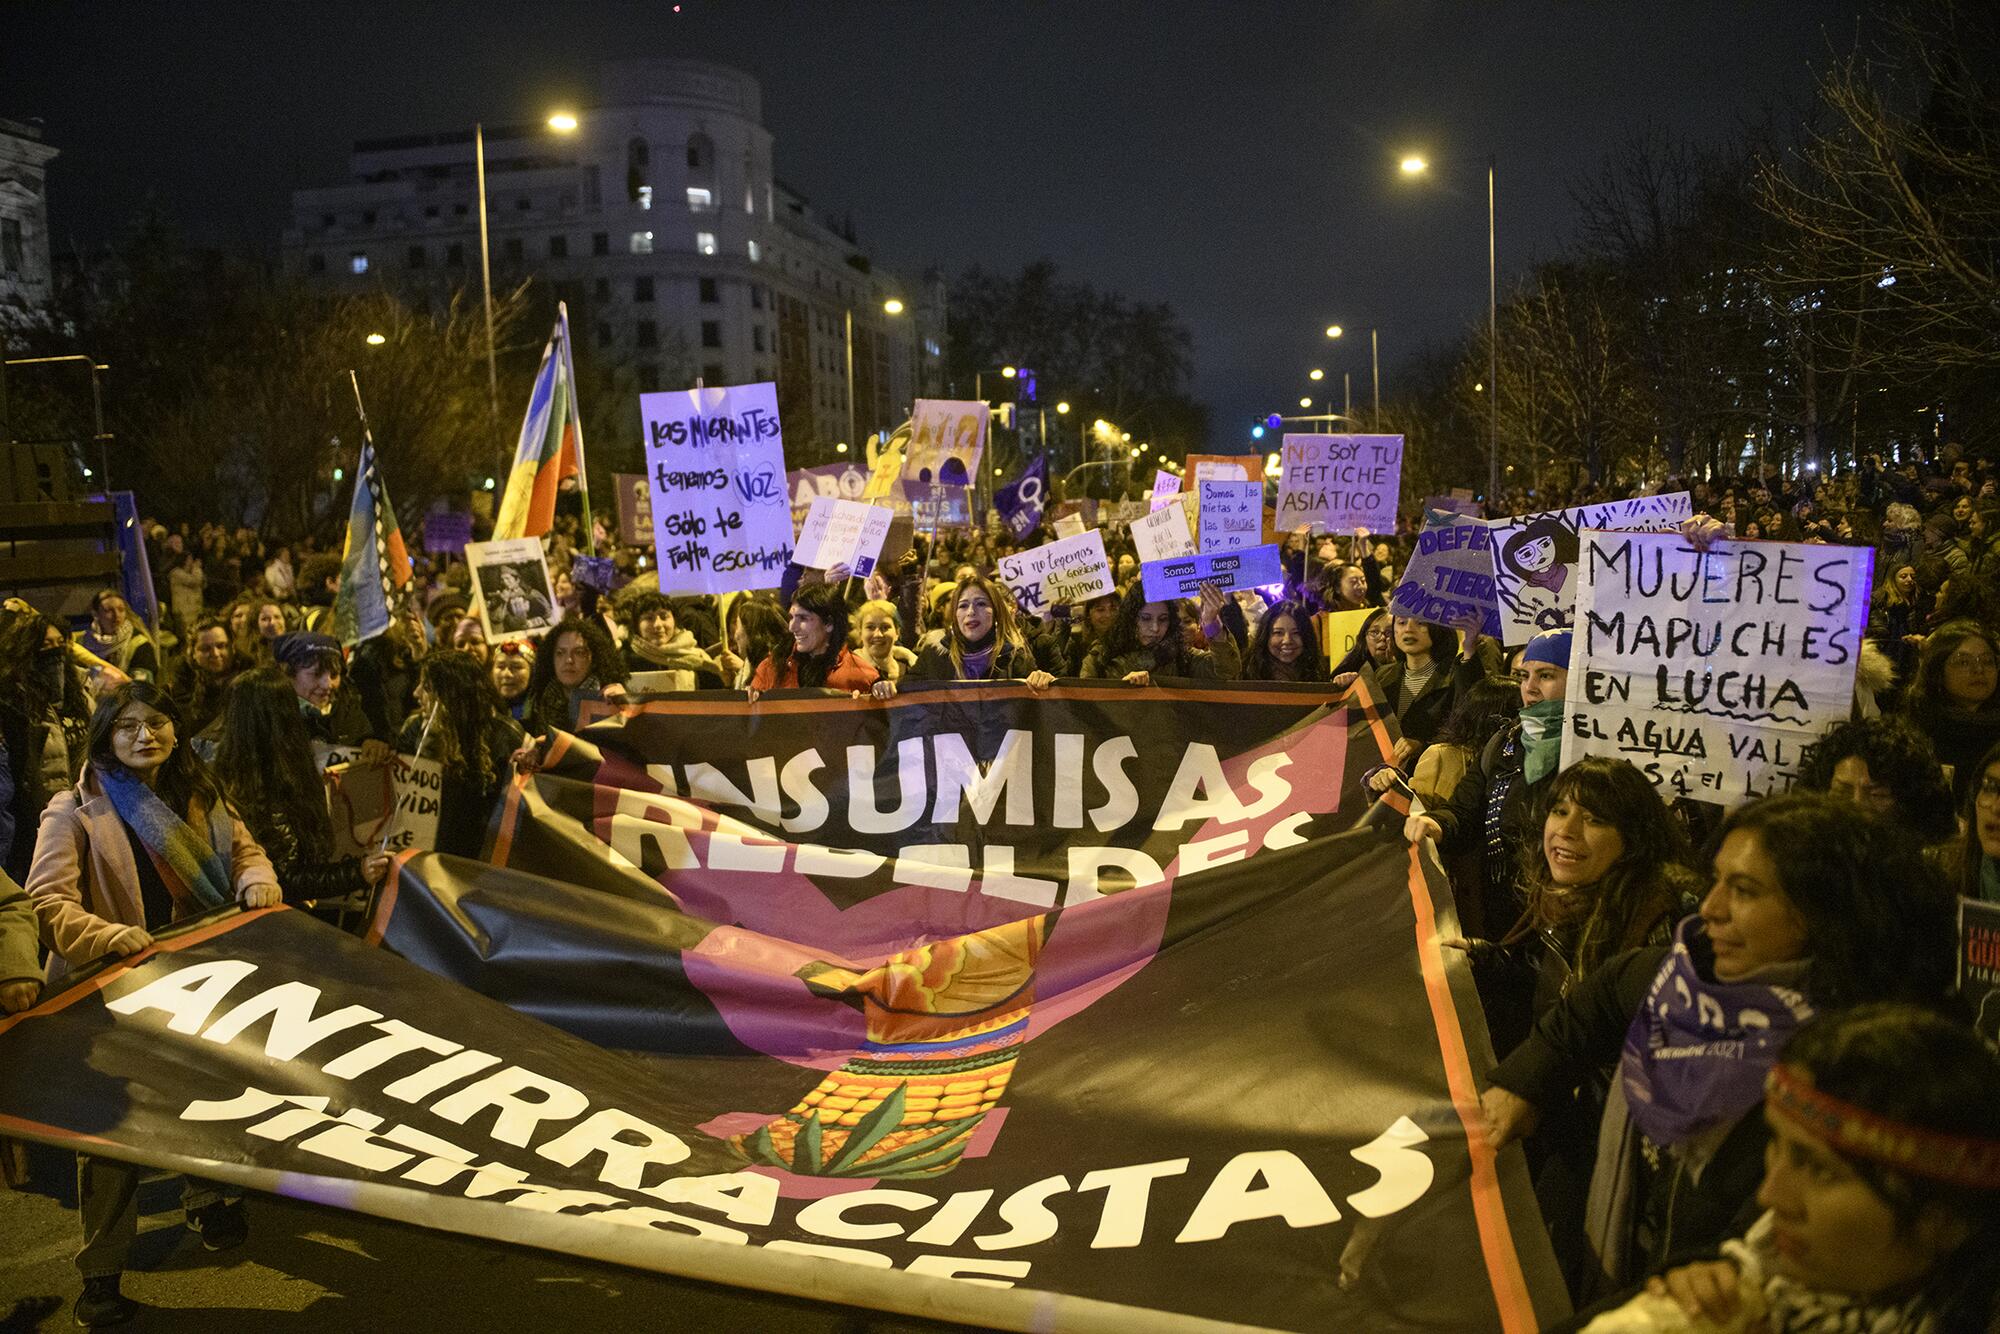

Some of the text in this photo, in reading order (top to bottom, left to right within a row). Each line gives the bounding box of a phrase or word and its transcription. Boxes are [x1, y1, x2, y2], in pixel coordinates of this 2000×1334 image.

[651, 408, 780, 448] Las MIGRANTES
[1286, 444, 1320, 463] NO
[1370, 446, 1399, 465] TU
[655, 463, 728, 493] tenemos
[1289, 466, 1386, 484] FETICHE
[1205, 483, 1259, 499] Somos las
[1282, 486, 1380, 511] ASIÁTICO
[1202, 501, 1249, 513] nietas de
[713, 507, 743, 538] te
[1204, 520, 1218, 531] las
[1205, 536, 1241, 548] que no
[1420, 525, 1491, 556] DEFE
[1003, 559, 1024, 581] Si
[1032, 559, 1046, 573] no
[1047, 573, 1063, 585] EL
[1164, 559, 1239, 577] Somos fuego
[1589, 538, 1849, 616] MUJERES
[1055, 578, 1103, 599] TAMPOCO
[1585, 610, 1850, 665] MAPUCHES
[1585, 664, 1808, 710] EN LUCHA
[1572, 713, 1609, 740] EL
[1617, 717, 1706, 758] AGUA
[648, 730, 1293, 834] INSUMISAS
[106, 960, 1435, 1250] ANTIRRACISTAS
